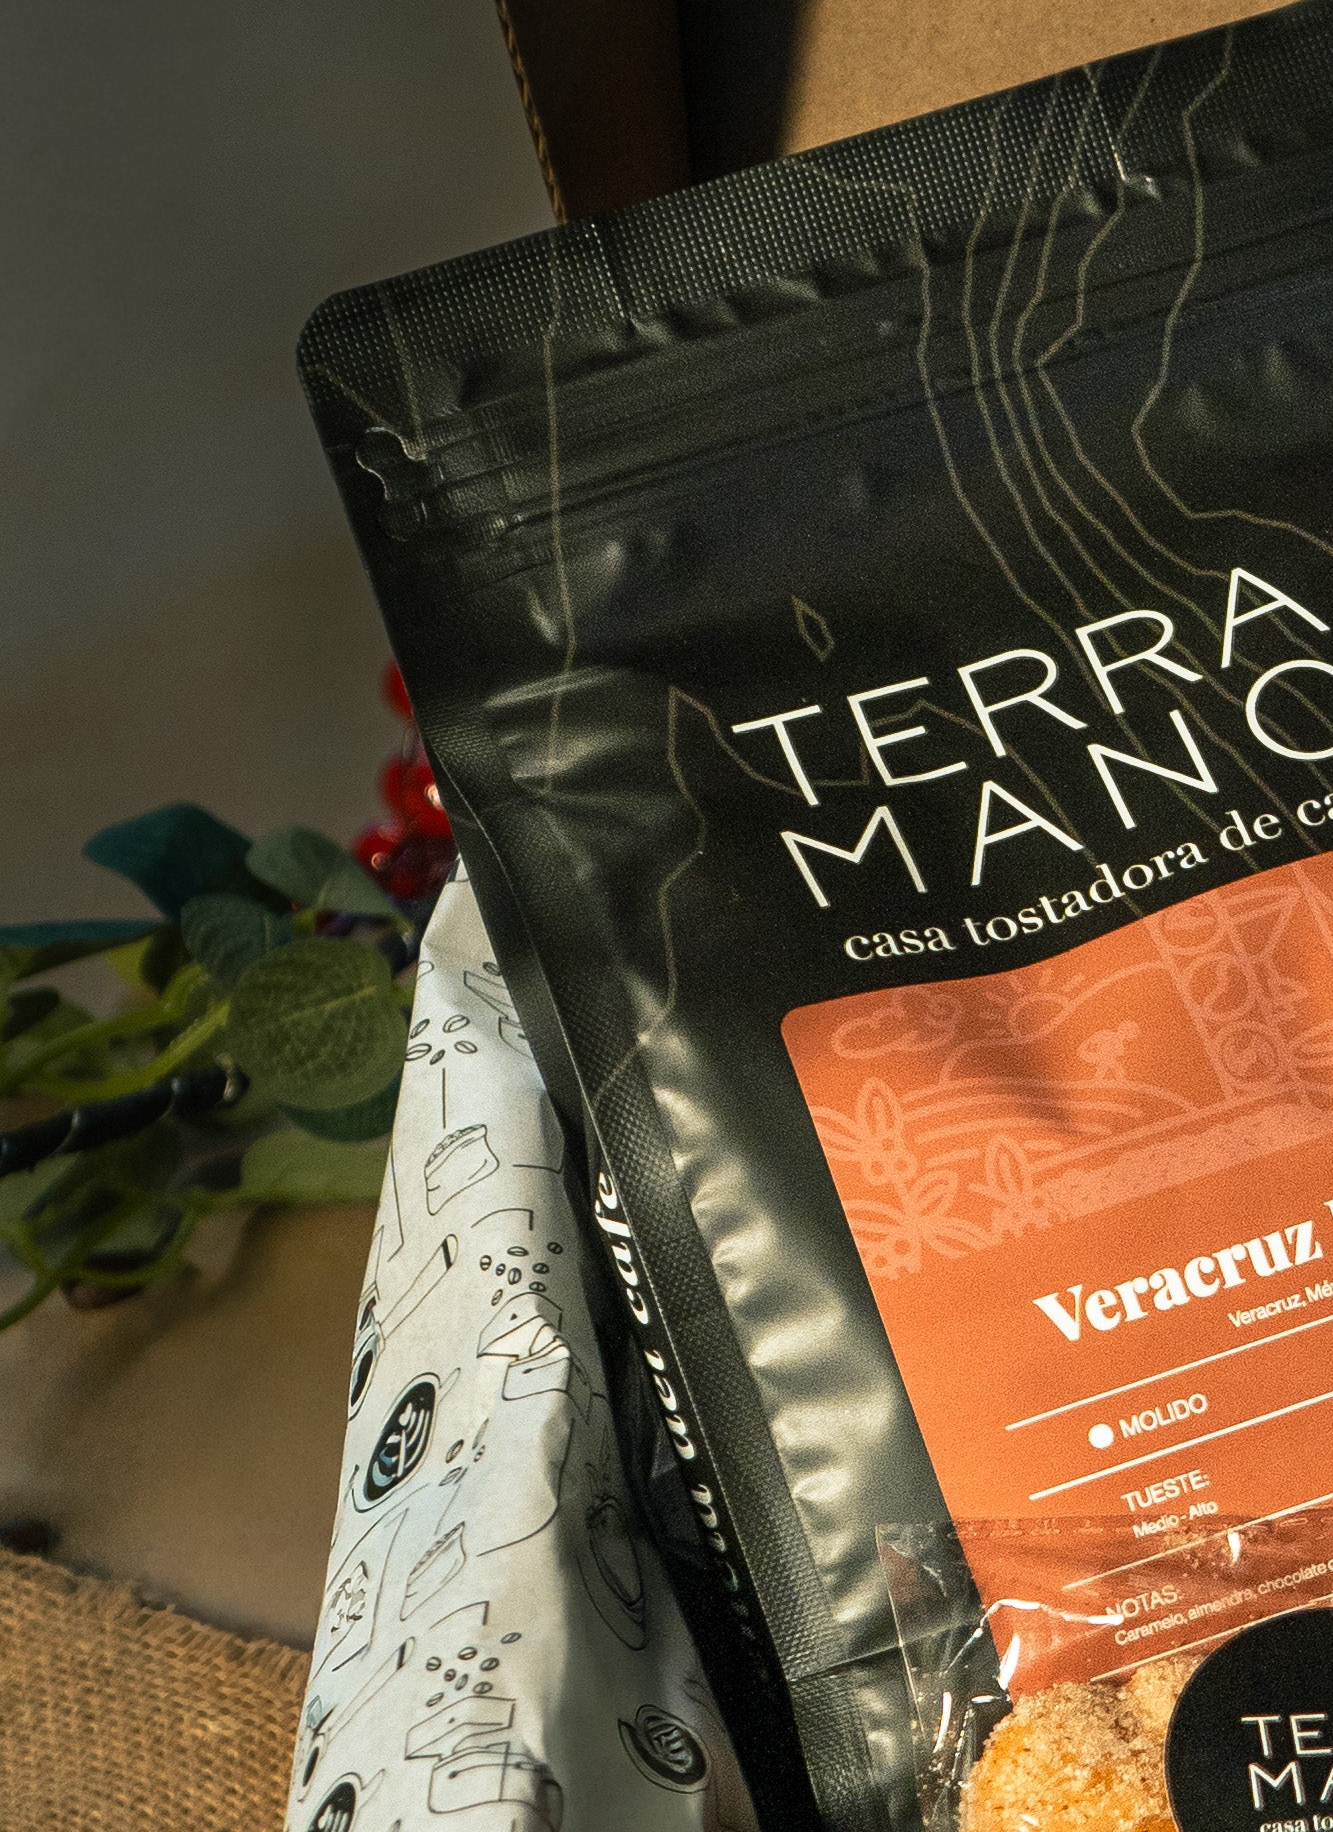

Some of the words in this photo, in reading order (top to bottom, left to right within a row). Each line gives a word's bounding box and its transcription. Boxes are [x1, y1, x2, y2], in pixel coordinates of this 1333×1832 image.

[732, 567, 1330, 807] TERRA
[843, 918, 957, 961] casa
[961, 840, 1208, 946] tostadora
[1220, 808, 1282, 852] de
[1033, 1221, 1323, 1342] Veracruz
[1119, 1392, 1209, 1440] MOLIDO
[1120, 1469, 1211, 1514] TUESTE:
[1132, 1513, 1179, 1539] Medio
[1188, 1499, 1219, 1521] Alto
[1258, 1562, 1327, 1595] chocolate
